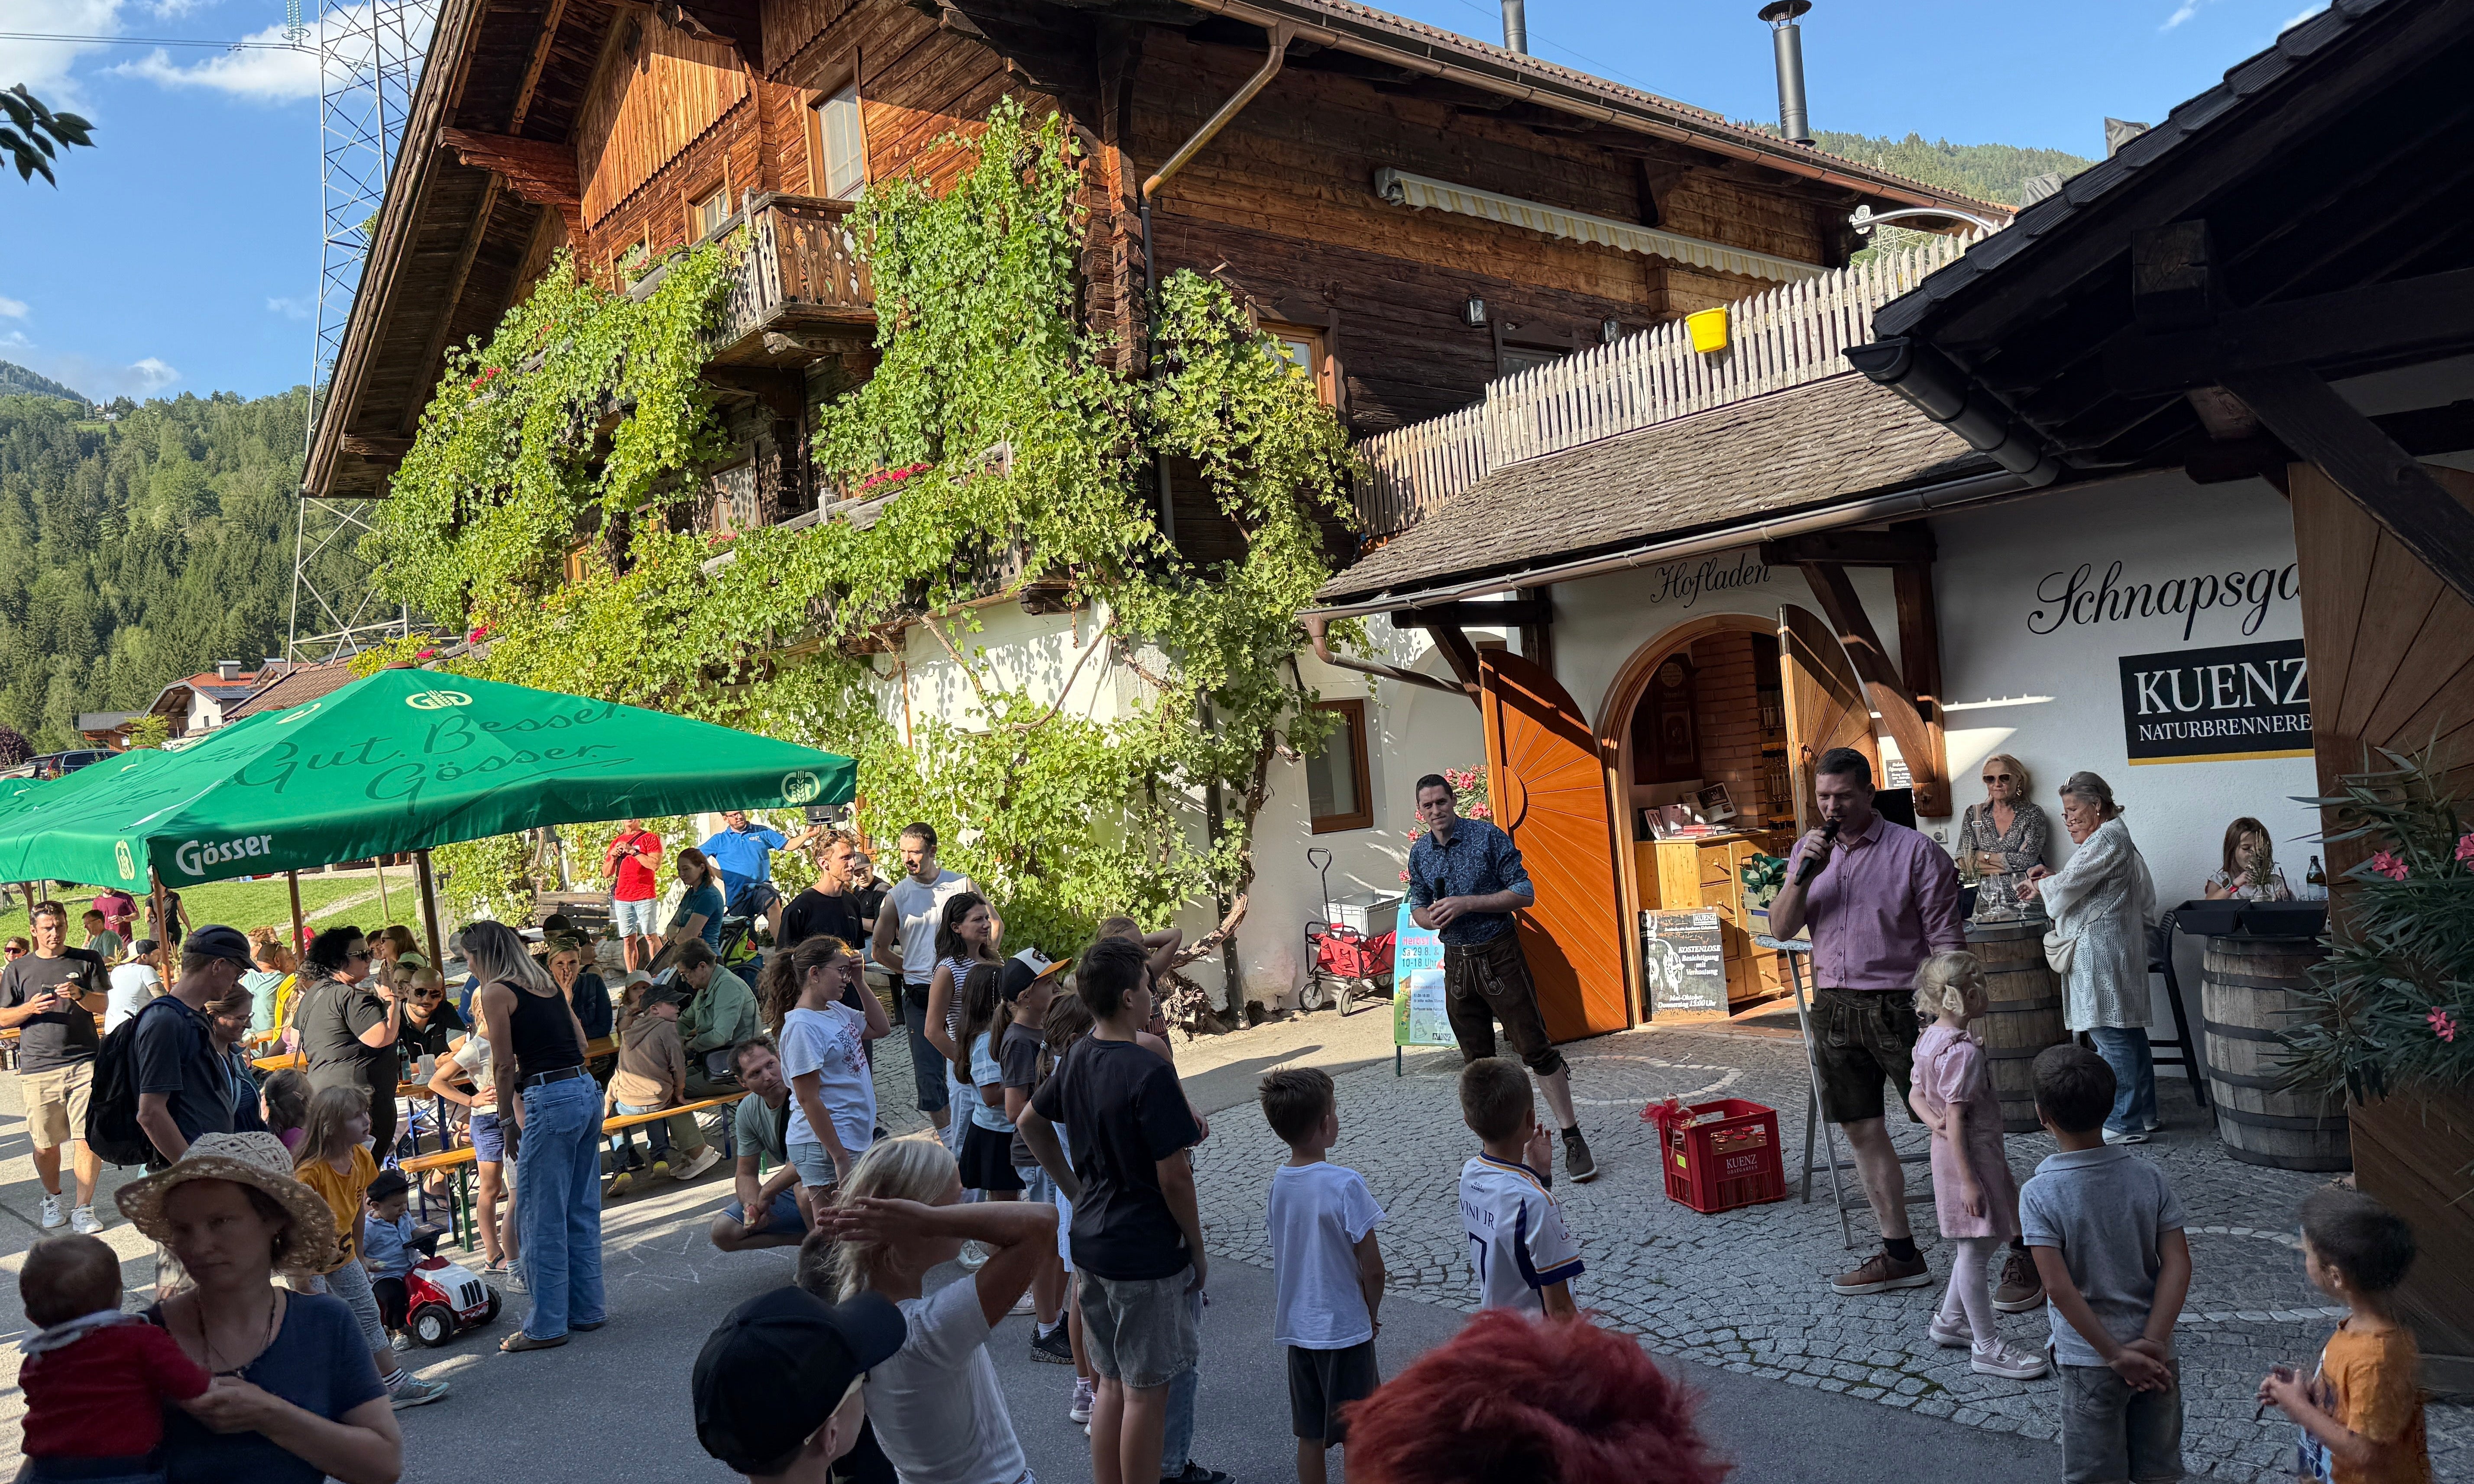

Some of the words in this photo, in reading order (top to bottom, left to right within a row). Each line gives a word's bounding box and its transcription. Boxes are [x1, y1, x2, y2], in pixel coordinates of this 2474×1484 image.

[1650, 553, 1771, 608] Hofladen
[2134, 657, 2309, 715] KUENZ
[175, 834, 272, 876] Gösser
[1402, 935, 1429, 946] Herbst
[1402, 947, 1410, 956] Sa
[1413, 947, 1431, 956] 29.8.
[1678, 944, 1721, 954] KOSTENLOSE
[1402, 958, 1422, 967] 10-18
[1425, 957, 1437, 967] Uhr
[1726, 1154, 1758, 1169] KUENZ
[1460, 1198, 1479, 1222] VINI
[1483, 1209, 1495, 1230] JR
